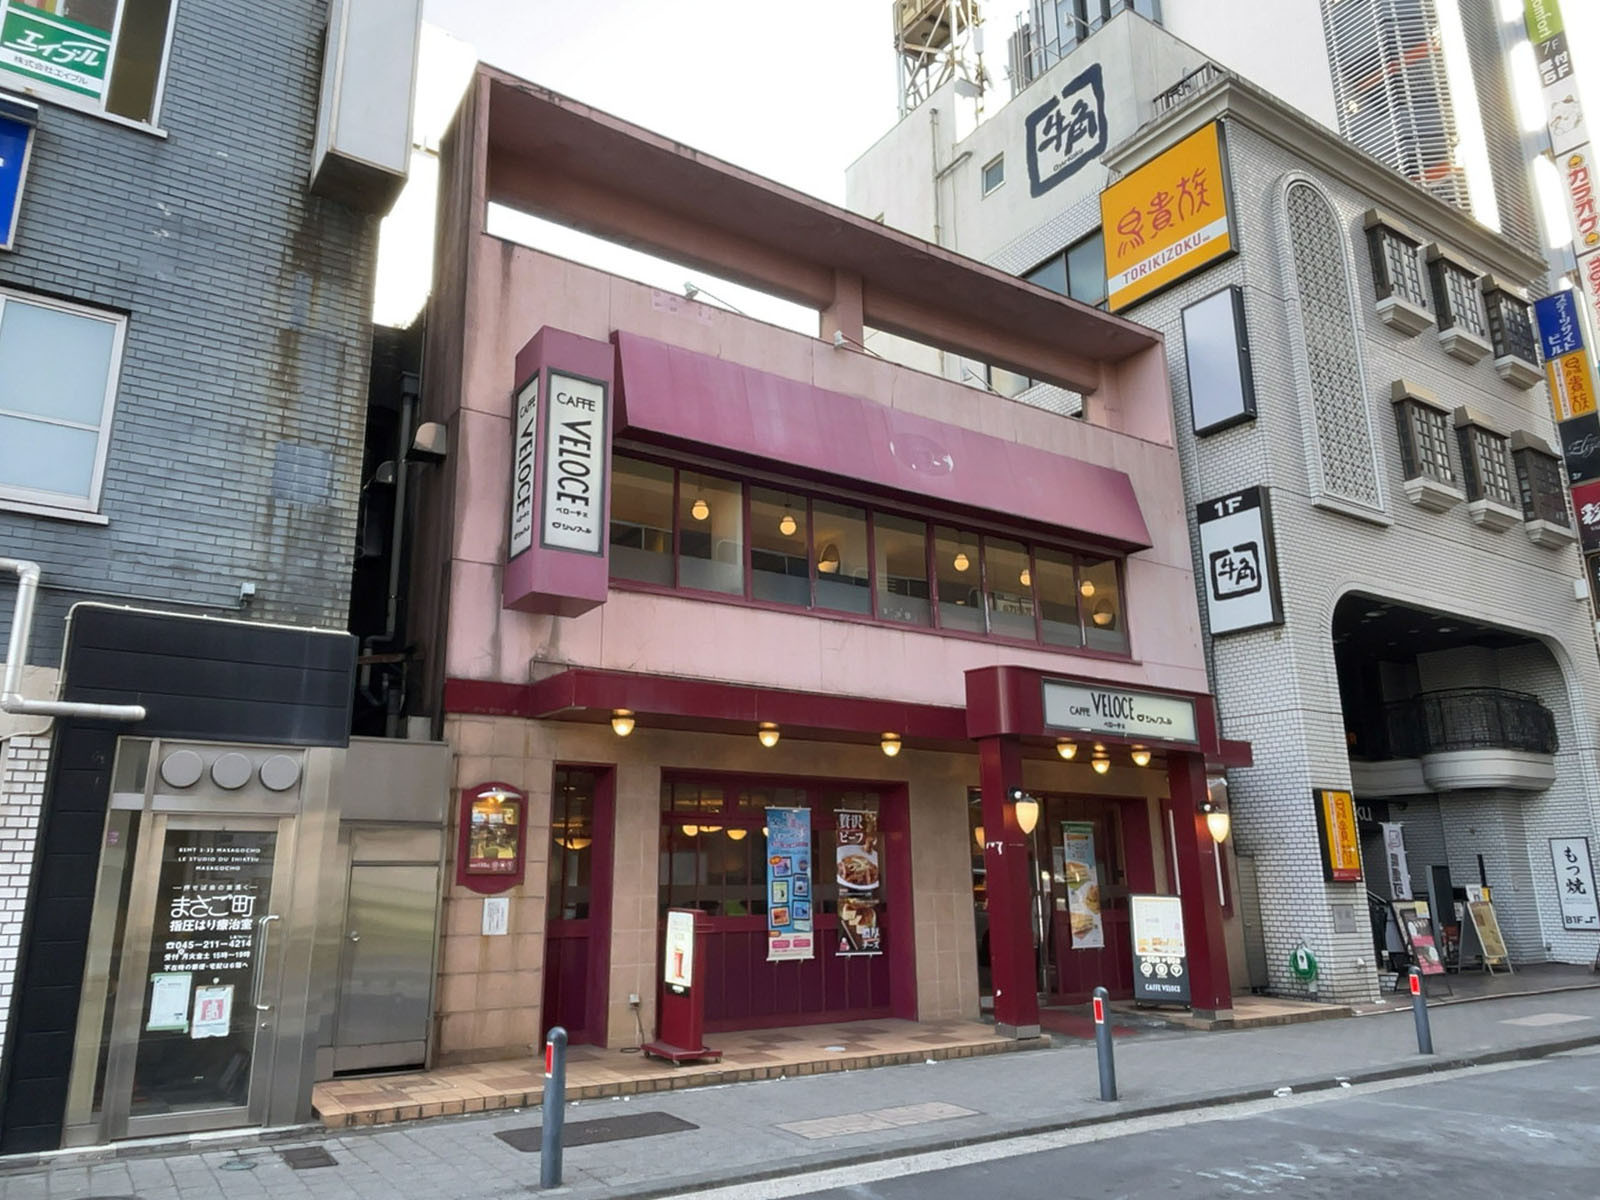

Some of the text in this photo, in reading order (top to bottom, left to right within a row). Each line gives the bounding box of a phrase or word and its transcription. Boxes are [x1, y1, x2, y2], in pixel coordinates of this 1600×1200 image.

[3, 29, 106, 66] エイブル
[1541, 38, 1559, 55] 7F
[14, 55, 88, 84] 株式会社エイブル
[1539, 50, 1568, 74] 受付
[1038, 99, 1097, 156] 牛角
[1117, 168, 1211, 258] 鳥貴族
[1568, 167, 1598, 235] カラオケ
[1122, 232, 1202, 284] TORIKIZOKU
[556, 391, 596, 413] CAFFE
[517, 417, 534, 512] VELOCE
[556, 420, 592, 506] VELOCE
[555, 507, 589, 519] ベローチェ
[1214, 495, 1242, 517] 1F
[1218, 556, 1256, 585] 牛角
[1069, 705, 1091, 717] CAFFE
[1091, 691, 1135, 721] VELOCE
[839, 832, 864, 843] ビーフ
[1563, 846, 1586, 895] もつ焼
[170, 894, 256, 918] まさご町
[1565, 915, 1584, 924] B1F
[169, 919, 253, 932] 指圧はり療治室
[863, 940, 880, 950] チーズ
